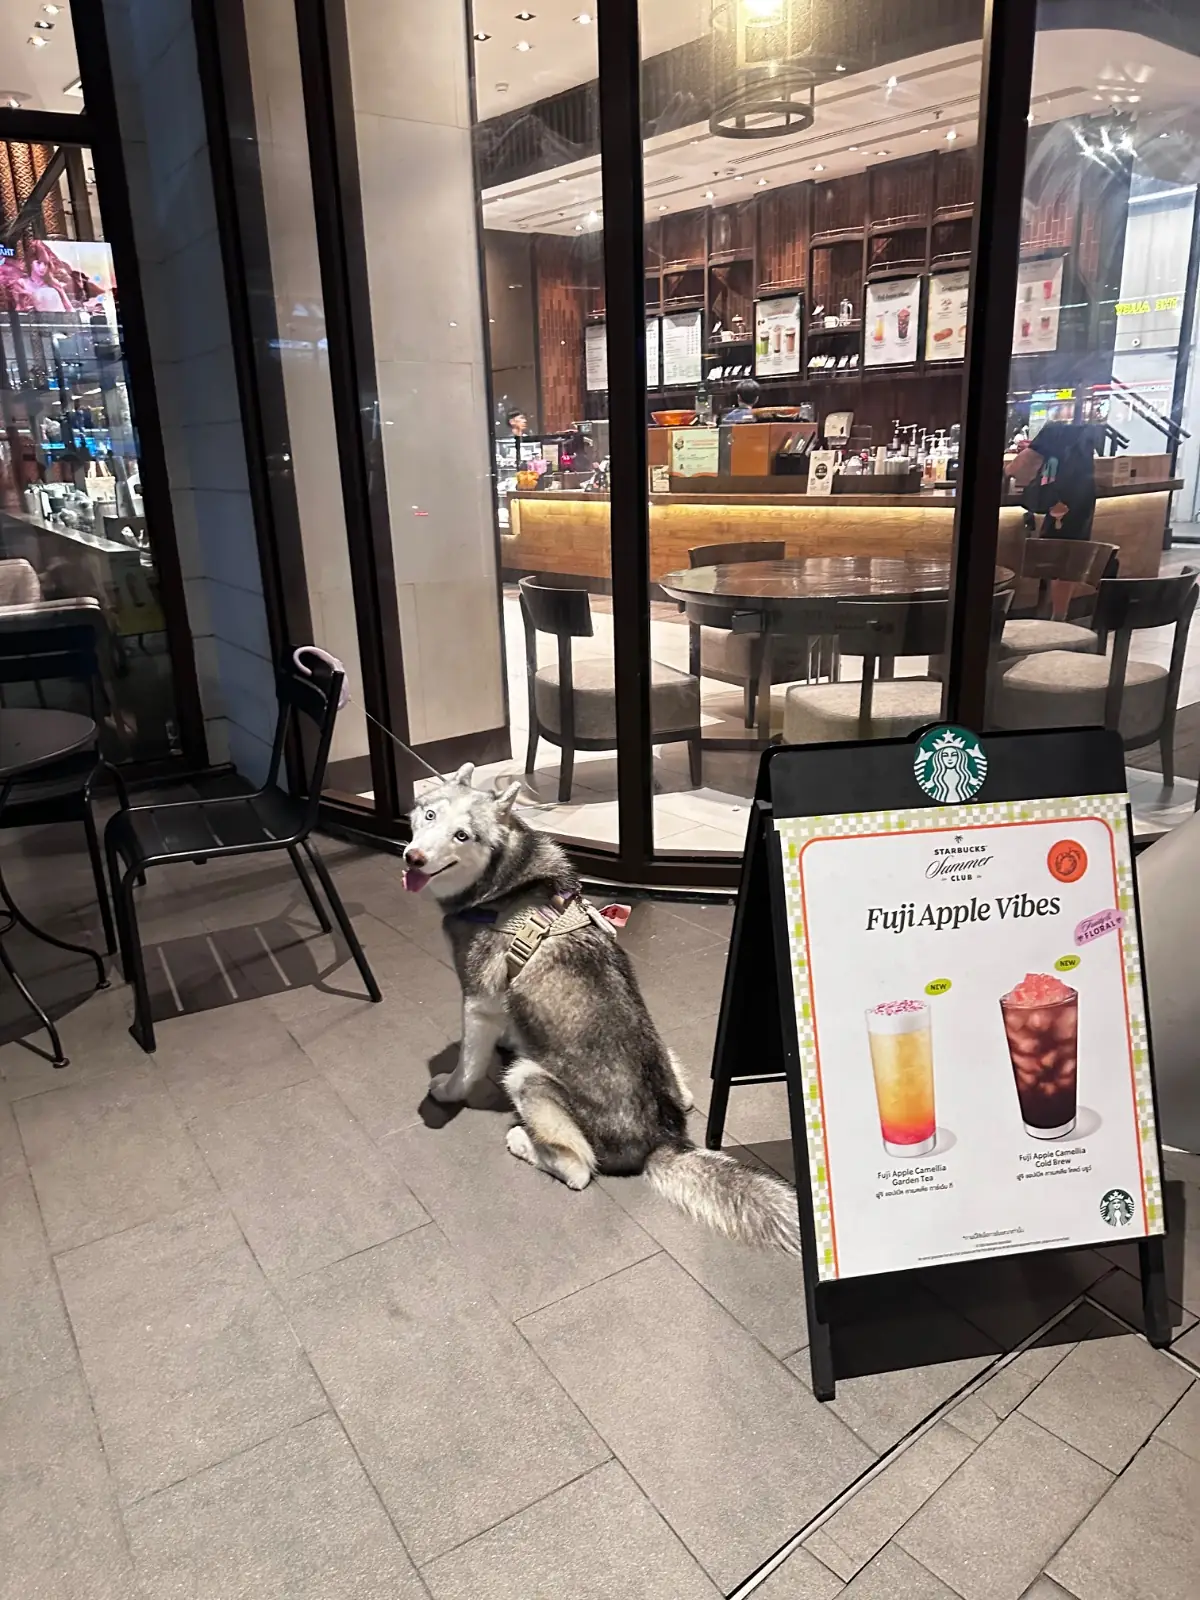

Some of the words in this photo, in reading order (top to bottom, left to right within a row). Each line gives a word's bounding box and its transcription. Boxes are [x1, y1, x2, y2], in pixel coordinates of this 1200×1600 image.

[934, 845, 986, 855] STARBUCKS
[925, 855, 994, 879] Summer
[950, 874, 973, 882] CLUB
[865, 903, 915, 934] Fuji
[917, 898, 991, 931] Apple
[996, 893, 1061, 919] Vibes
[1084, 920, 1116, 939] FLORAL
[1060, 958, 1076, 967] NEW
[930, 983, 947, 991] NEW
[1019, 1153, 1032, 1162] Fuji
[1033, 1151, 1054, 1160] Apple
[1055, 1147, 1086, 1157] Camellia
[1035, 1159, 1052, 1168] Cold
[1053, 1158, 1071, 1166] Brew
[877, 1170, 891, 1179] Fuji
[892, 1168, 914, 1178] Apple
[915, 1164, 947, 1174] Camellia
[892, 1177, 919, 1186] Garden
